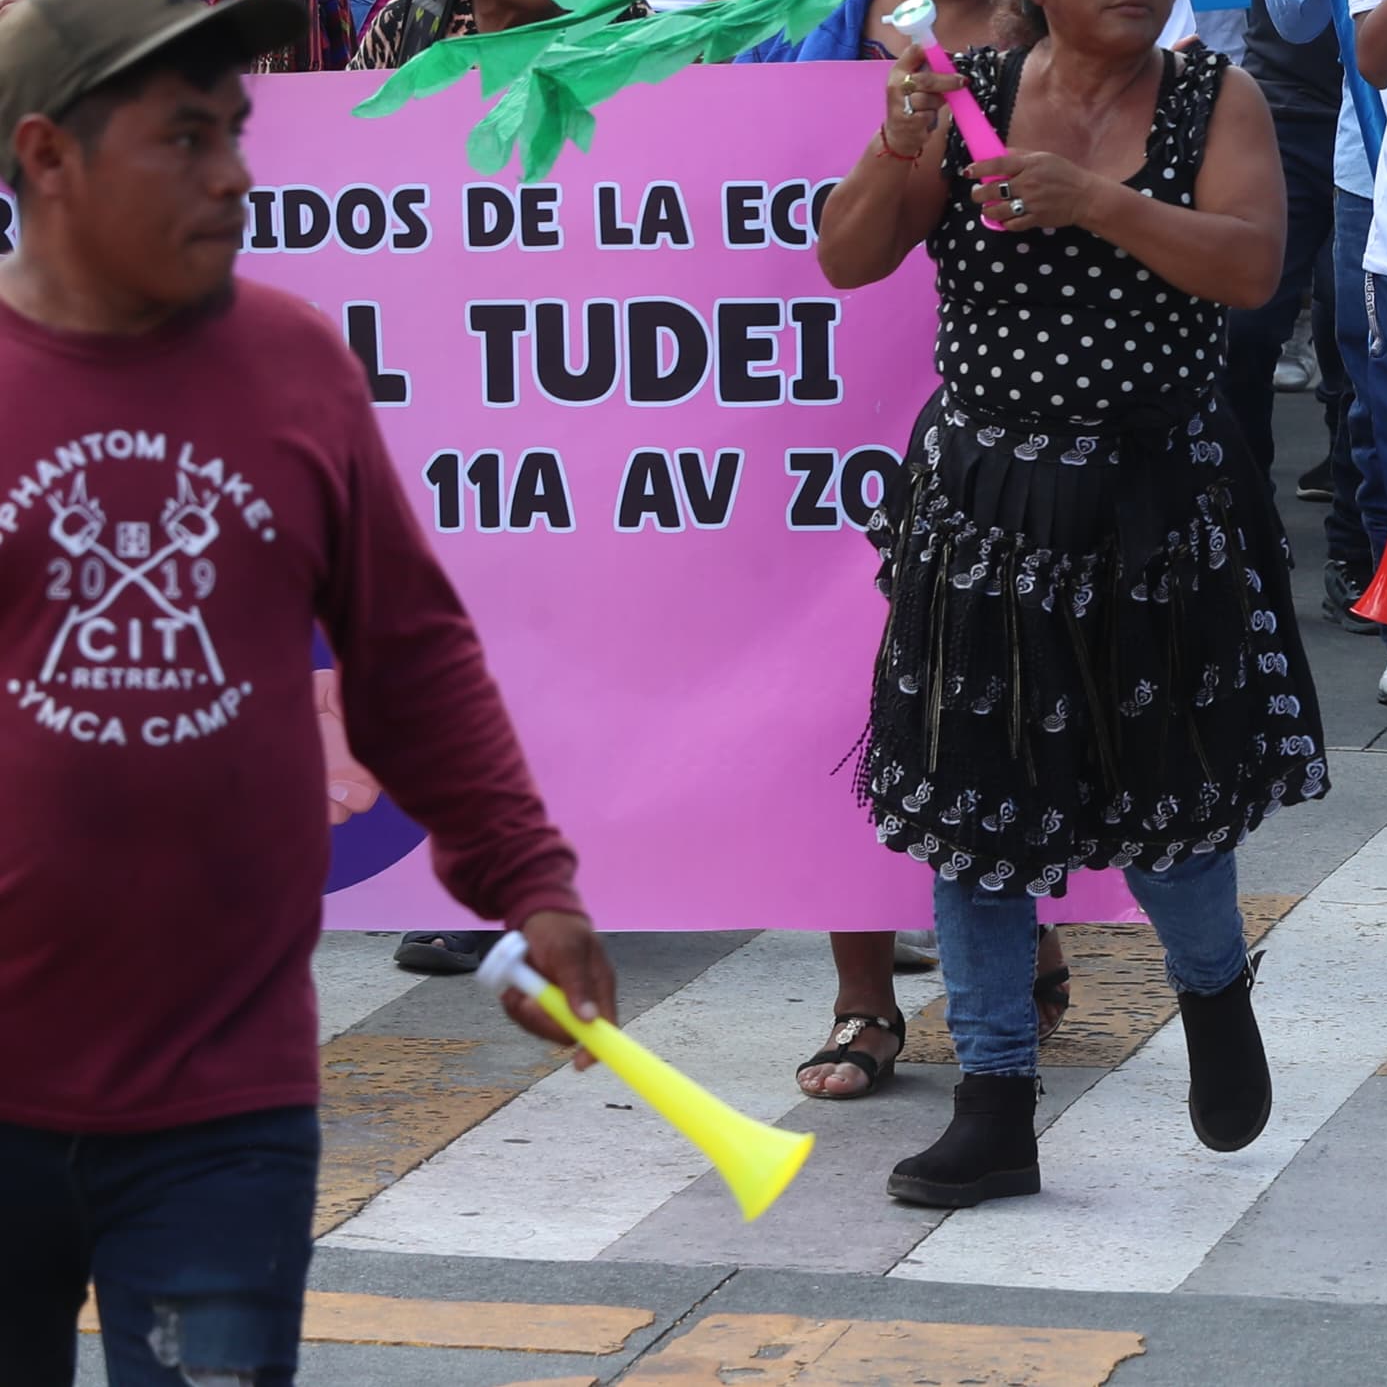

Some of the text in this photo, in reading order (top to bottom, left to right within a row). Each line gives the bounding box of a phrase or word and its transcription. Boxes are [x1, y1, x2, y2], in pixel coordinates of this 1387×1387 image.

[240, 187, 430, 251] IDOS
[466, 186, 560, 248] DE
[598, 184, 690, 246] LA
[469, 300, 841, 404] TUDEI
[0, 429, 274, 532] PHANTOM LAKE
[426, 451, 573, 530] 11A
[617, 451, 742, 529] AV
[76, 616, 188, 663] CIT
[71, 667, 196, 690] RETREAT
[18, 680, 241, 746] YMCA CAMP
